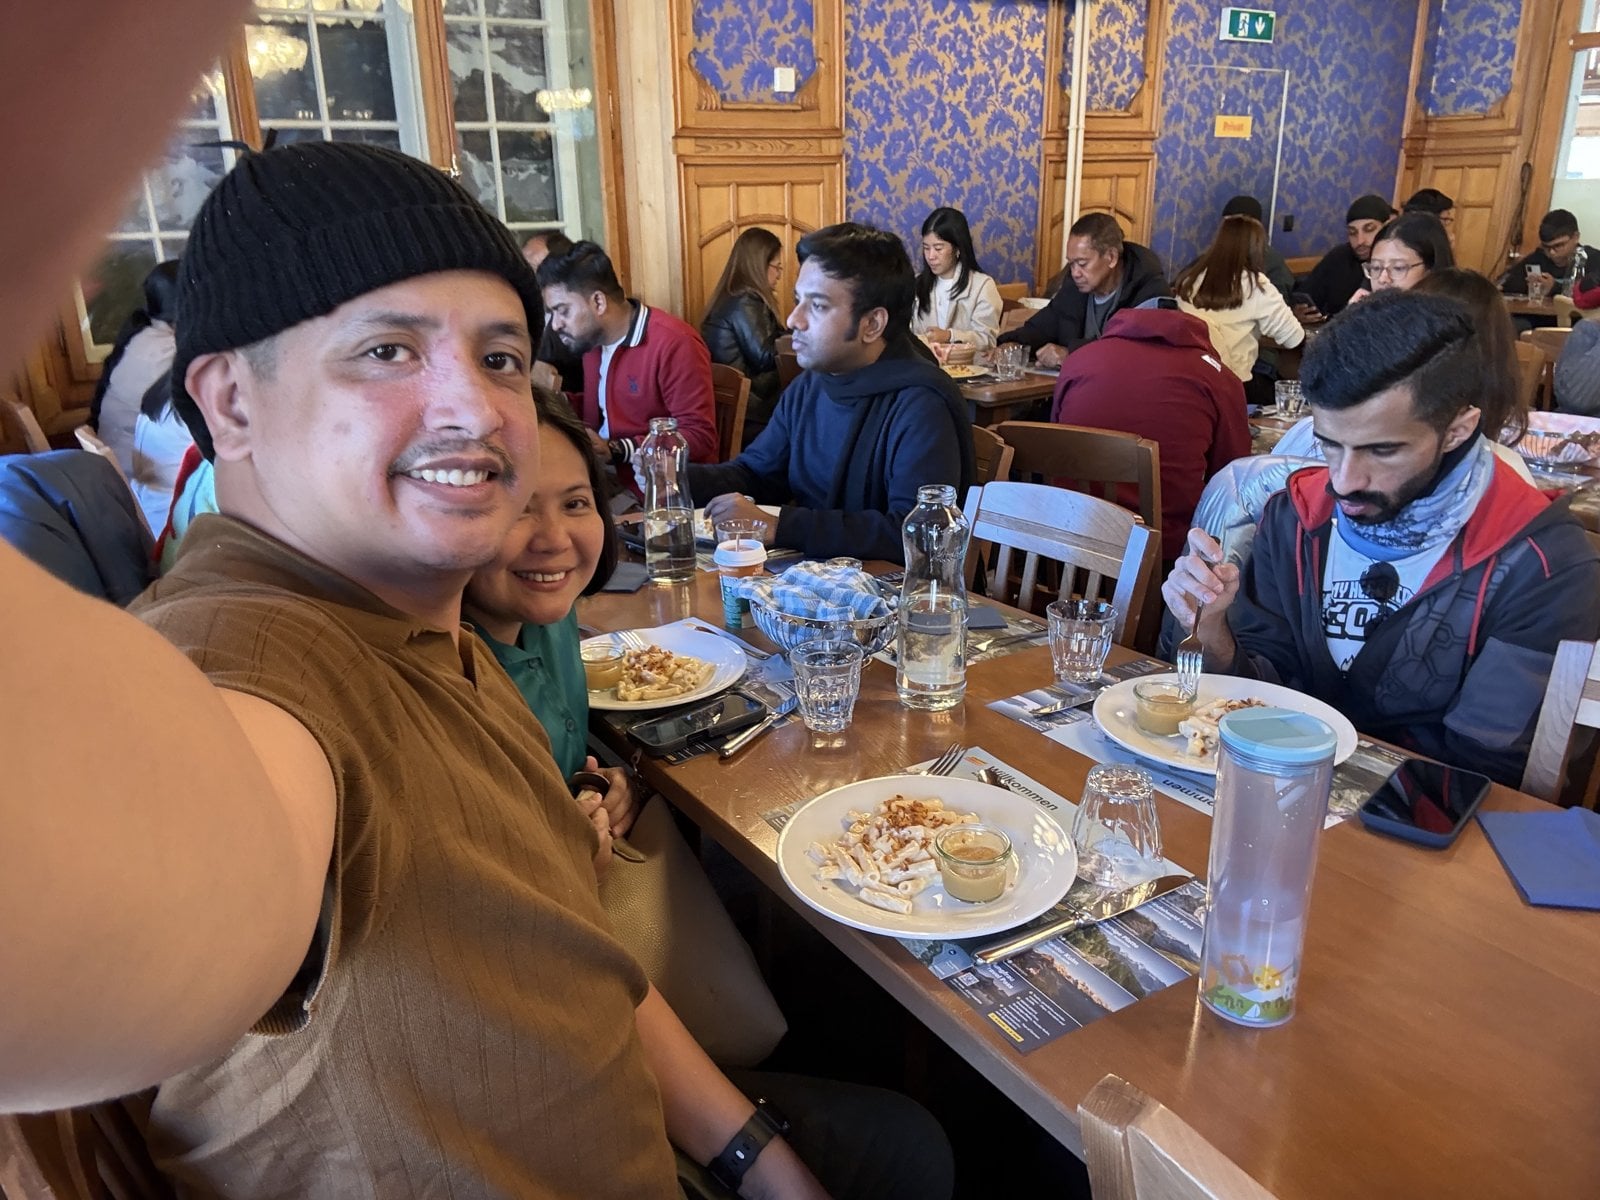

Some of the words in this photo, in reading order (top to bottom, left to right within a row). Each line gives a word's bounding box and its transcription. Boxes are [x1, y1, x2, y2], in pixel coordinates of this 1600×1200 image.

[989, 766, 1058, 811] Willkommen
[1162, 779, 1214, 807] ommen
[993, 962, 1015, 982] ungfrau
